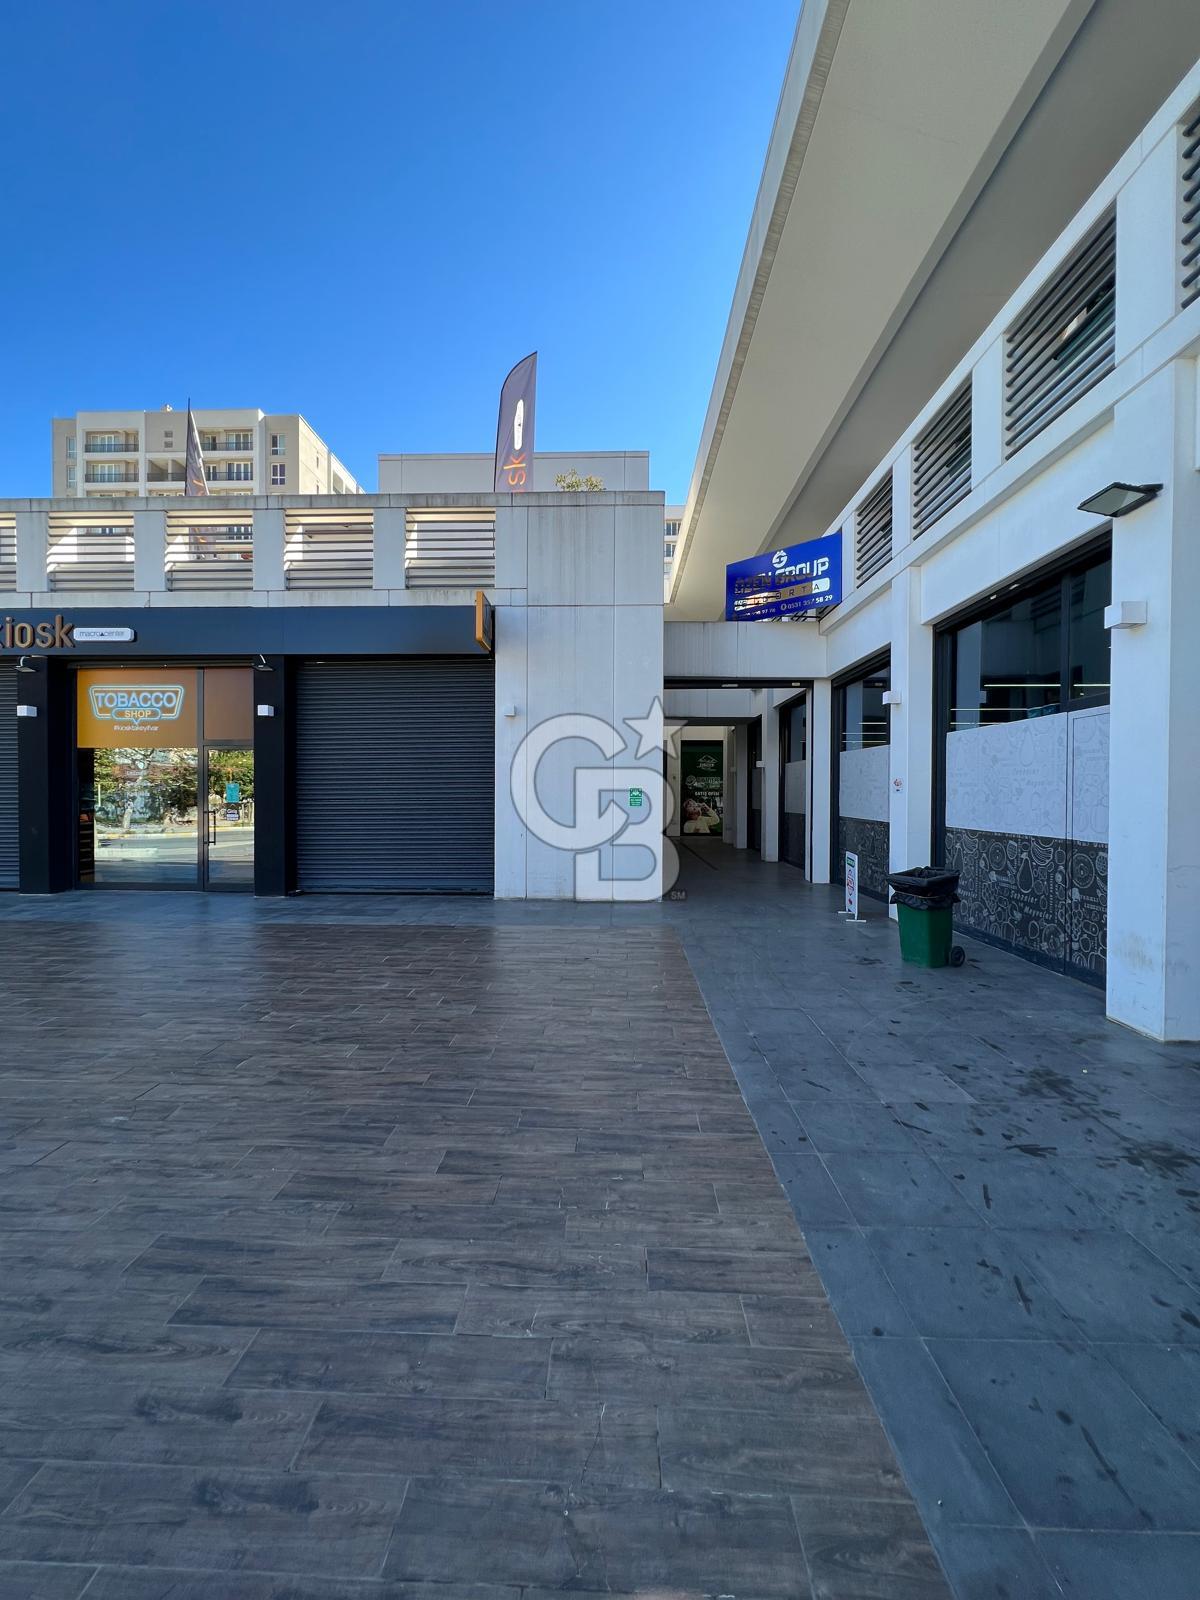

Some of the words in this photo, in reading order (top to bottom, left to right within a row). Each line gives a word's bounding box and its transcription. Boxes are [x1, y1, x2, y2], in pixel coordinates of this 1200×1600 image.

[503, 453, 527, 492] sk
[824, 594, 833, 602] 29
[0, 614, 75, 648] iosk
[94, 691, 177, 708] TOBACCO
[124, 710, 152, 718] SHOP
